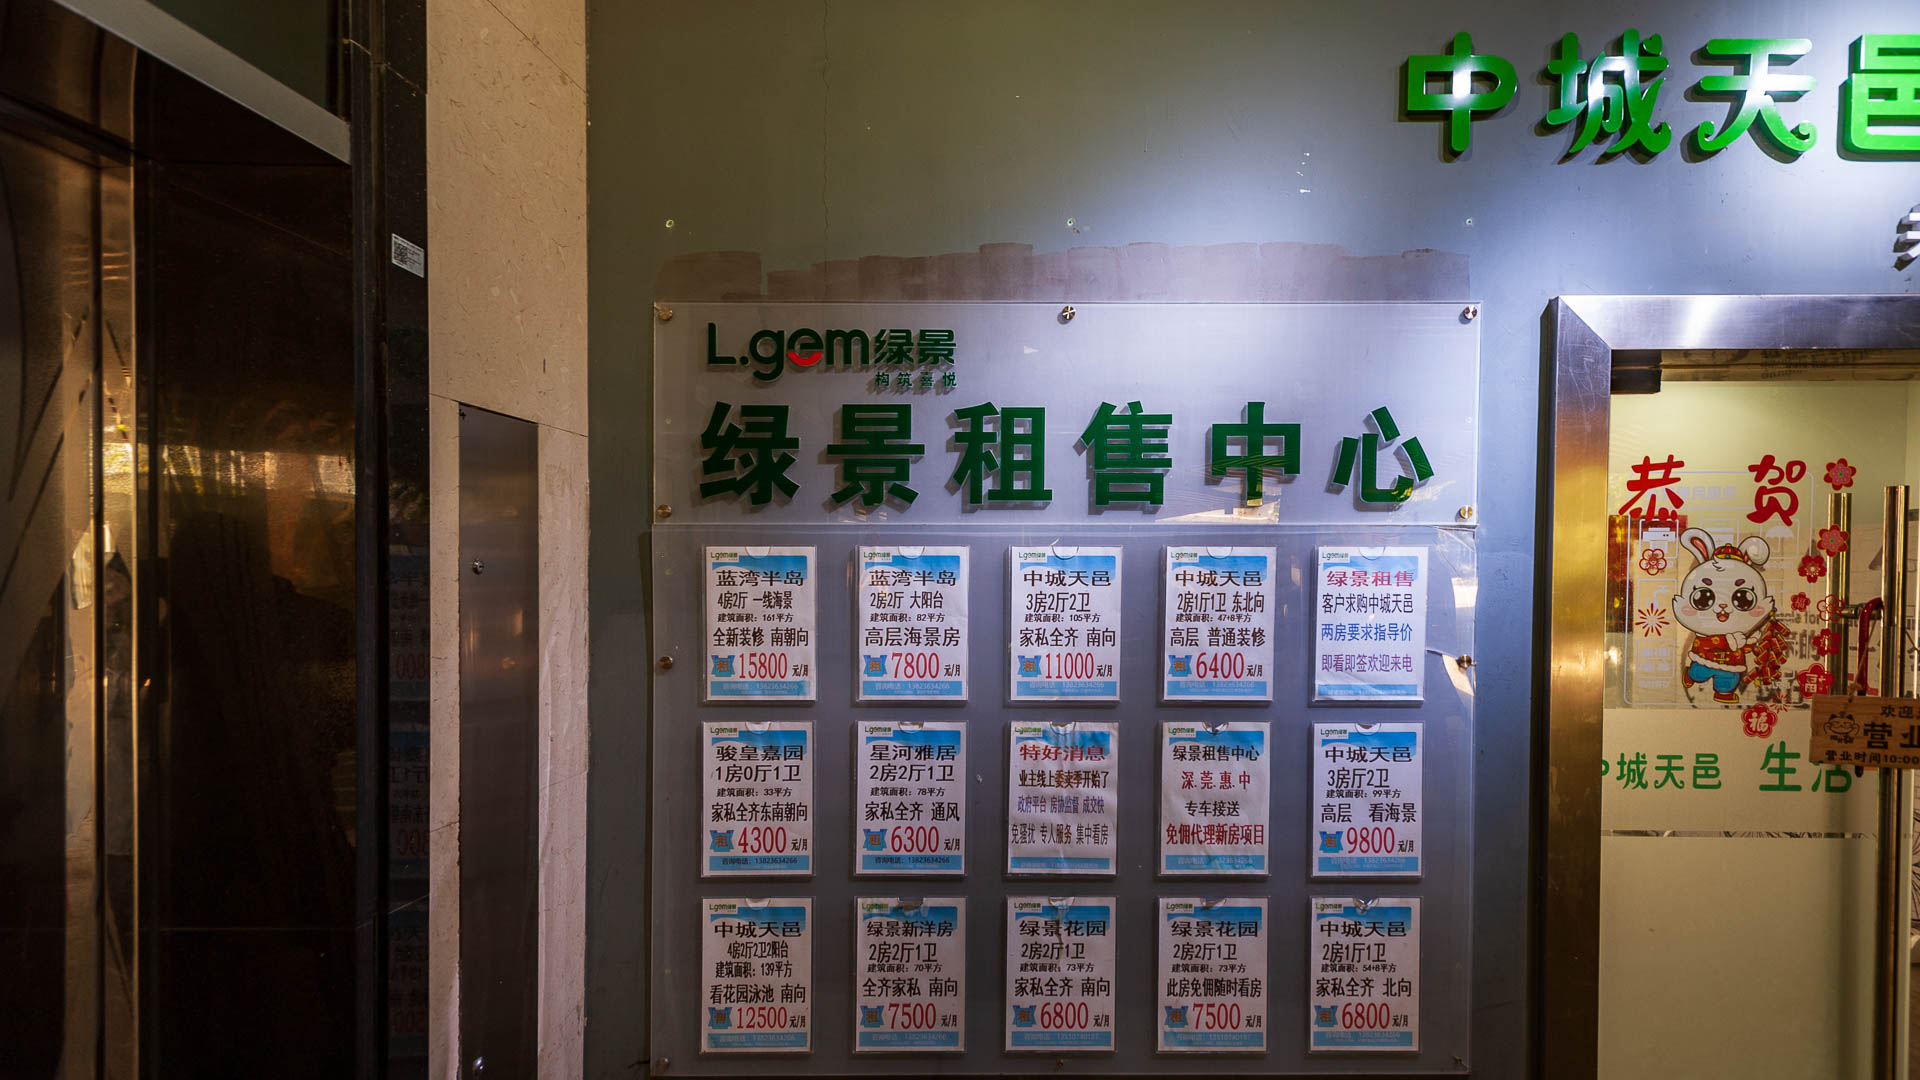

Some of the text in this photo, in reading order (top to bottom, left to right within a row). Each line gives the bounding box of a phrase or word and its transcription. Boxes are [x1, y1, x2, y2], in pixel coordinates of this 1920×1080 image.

[1406, 28, 1920, 153] 中城天邑
[699, 400, 1435, 507] 绿景租售中心
[1618, 454, 1807, 526] 恭贺
[716, 570, 803, 586] 蓝湾半岛
[869, 570, 956, 586] 蓝湾半岛
[1024, 570, 1111, 587] 中城天邑
[1175, 570, 1262, 587] 中城天邑
[1327, 571, 1414, 587] 绿景租售
[718, 591, 793, 609] 4房2厅 一线海景
[870, 591, 943, 609] 2房2厅 大阳台
[1026, 591, 1090, 613] 3房2厅2卫
[1177, 591, 1264, 613] 2房1厅1卫 东北向
[1322, 593, 1413, 614] 客户求购中城天邑
[713, 627, 808, 647] 全新装修 南朝向
[865, 627, 960, 647] 高层海景房
[1020, 627, 1115, 647] 家私全齐 南向
[1170, 627, 1266, 647] 高层 普通装修
[1321, 623, 1413, 641] 两房要求指导价
[739, 653, 808, 679] 15800 元/月
[891, 653, 960, 679] 7800 元/月
[1046, 653, 1112, 679] 11000 元/月
[1196, 652, 1263, 678] 6400 元/月
[1322, 654, 1413, 672] 即看即签欢迎来电
[1748, 711, 1770, 733] 福
[1880, 705, 1920, 719] 欢迎
[716, 745, 803, 761] 骏皇嘉园
[870, 745, 956, 761] 星河雅居
[1020, 744, 1105, 761] 特好消息
[1173, 745, 1259, 761] 绿景租售中心
[1325, 747, 1412, 763] 中城天邑
[716, 764, 801, 782] 1房0厅1卫
[870, 764, 954, 781] 2房2厅1卫
[1328, 767, 1389, 788] 3房厅2卫
[712, 802, 807, 822] 家私全齐东南朝向
[865, 802, 960, 821] 家私全齐 通风
[1017, 796, 1046, 814] 政府平台
[1083, 796, 1105, 814] 成交快
[1185, 801, 1240, 816] 专车接送
[1321, 803, 1416, 823] 高层 看海景
[738, 827, 807, 853] 4300 元/月
[891, 826, 960, 853] 6300 元/月
[1012, 824, 1108, 845] 免骚扰 专人服务 集中看房
[1166, 824, 1264, 845] 免佣代理新房项目
[1347, 827, 1414, 853] 9800 元/月
[714, 922, 801, 938] 中城天邑
[867, 921, 953, 937] 绿景新洋房
[1020, 920, 1106, 936] 绿景花园
[1171, 921, 1258, 937] 绿景花园
[1320, 921, 1407, 937] 中城天邑
[727, 941, 788, 959] 4房2厅2卫2阳台
[869, 942, 937, 963] 2房2厅1卫
[1021, 942, 1085, 960] 2房2厅1卫
[1173, 942, 1237, 961] 2房2厅1卫
[1323, 942, 1386, 963] 2房1厅1卫
[710, 984, 805, 1004] 看花园泳池 南向
[863, 977, 957, 997] 全齐家私 南向
[1015, 977, 1110, 997] 家私全齐 南向
[1167, 978, 1262, 998] 此房免佣随时看房
[1316, 977, 1412, 997] 家私全齐 北向
[737, 1007, 805, 1029] 12500 元/月
[888, 1003, 957, 1029] 7500 元/月
[1041, 1002, 1109, 1029] 6800 元/月
[1193, 1003, 1261, 1029] 7500 元/月
[1342, 1003, 1408, 1029] 6800 元/月
